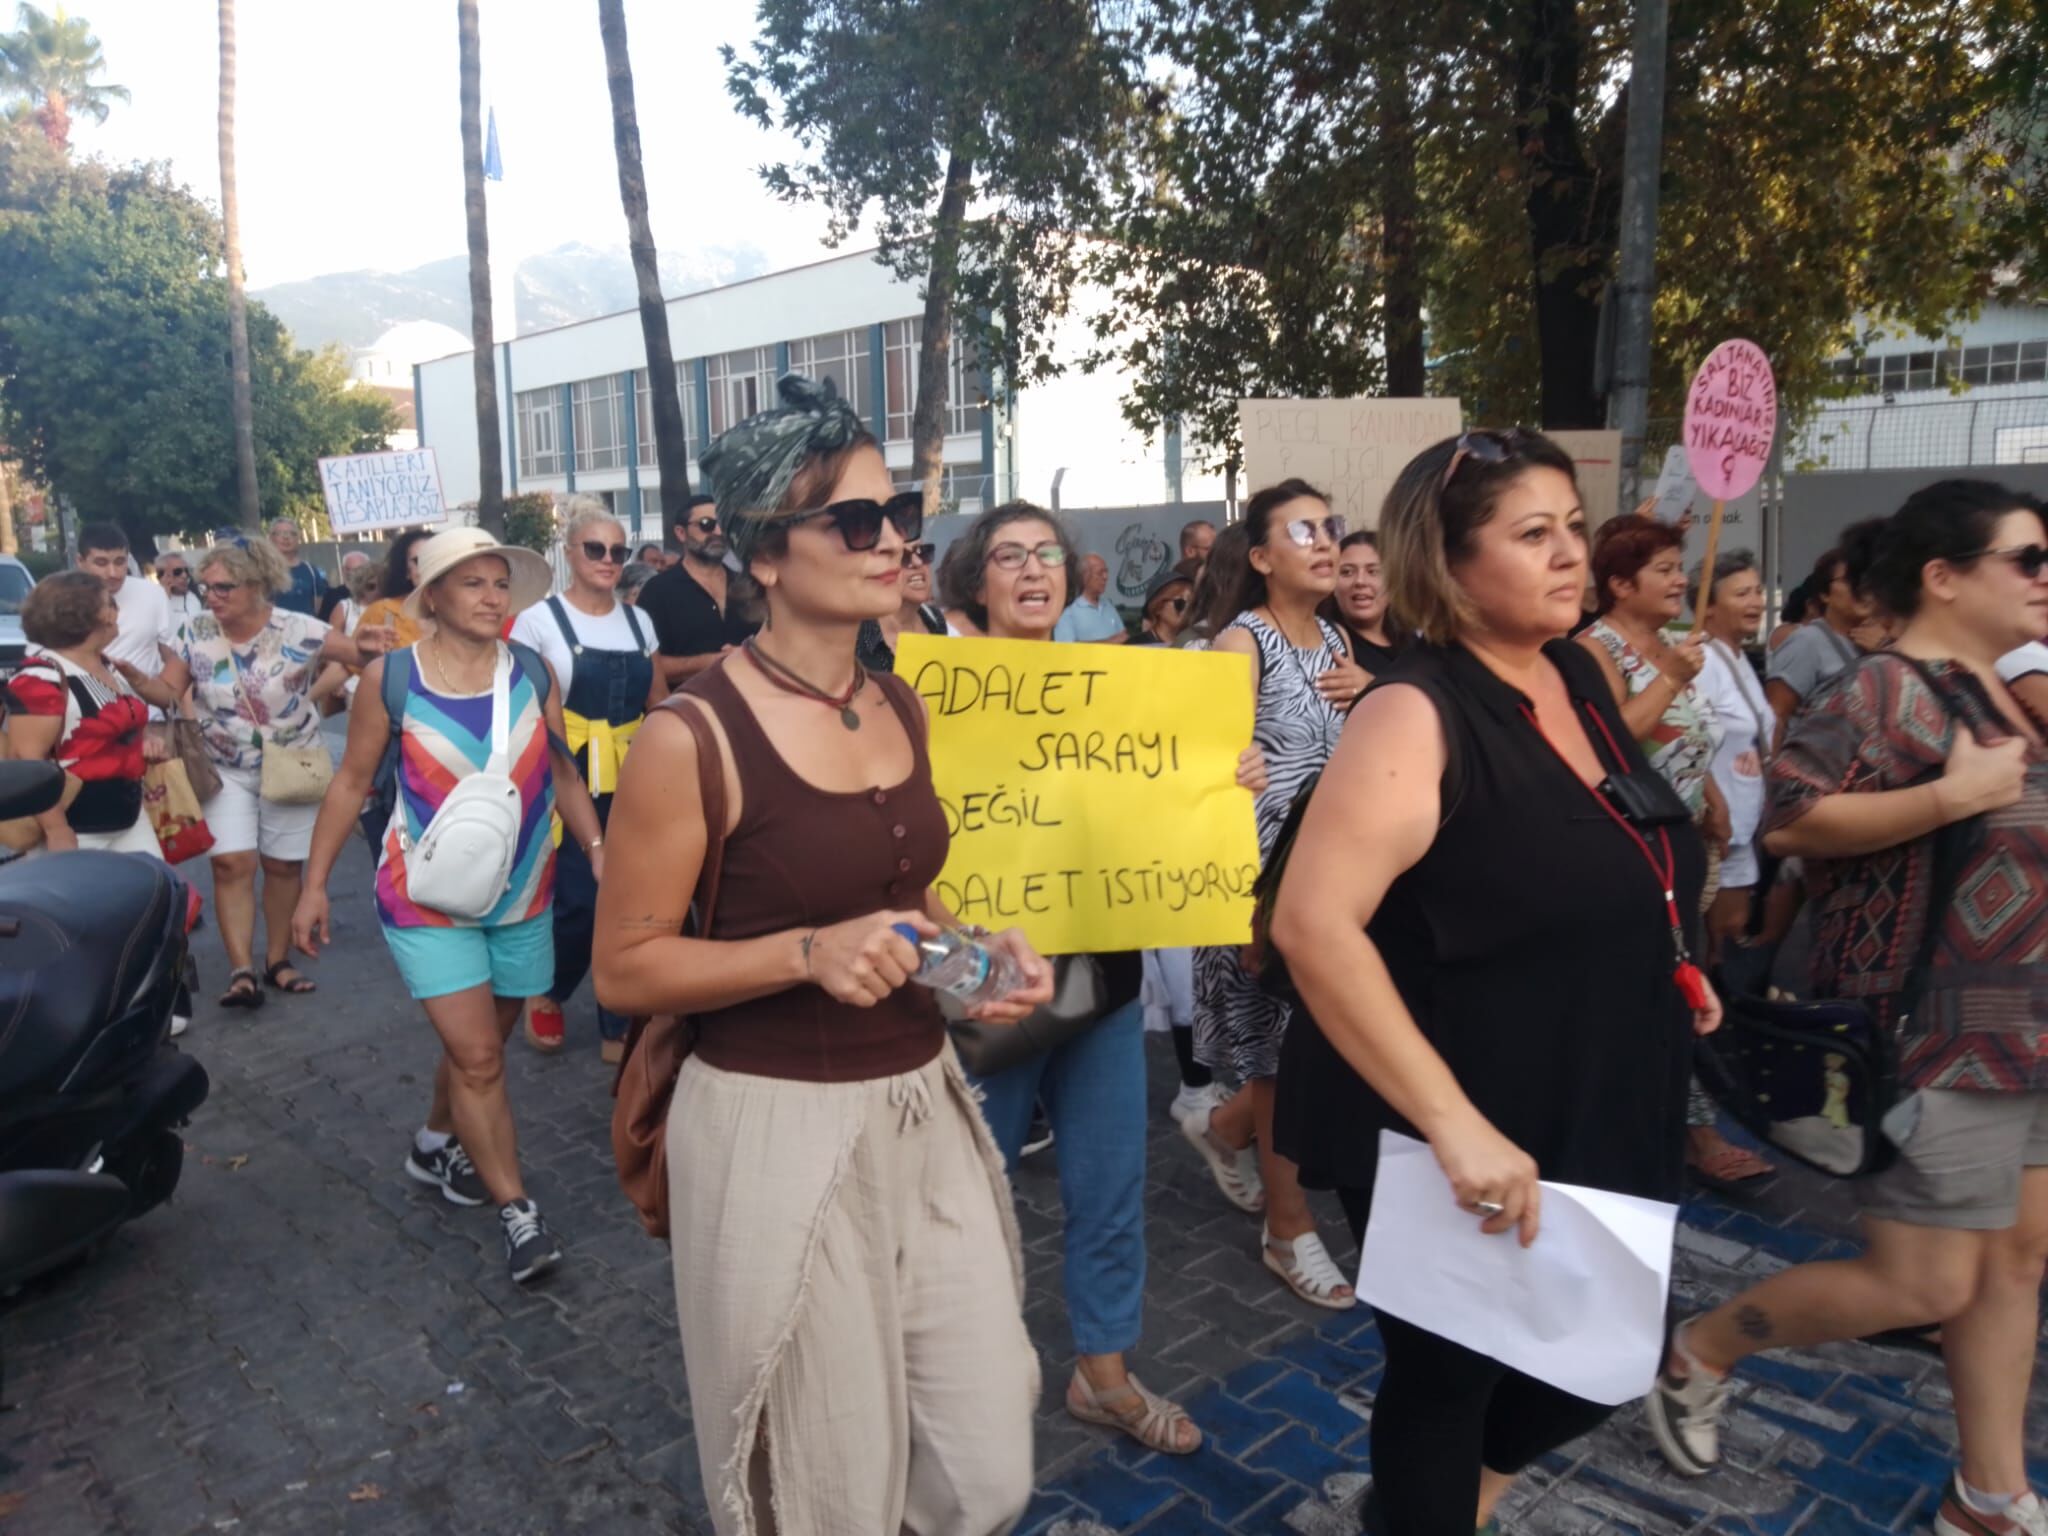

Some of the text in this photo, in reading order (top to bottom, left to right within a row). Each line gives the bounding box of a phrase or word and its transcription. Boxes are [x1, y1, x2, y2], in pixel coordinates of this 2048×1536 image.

[1693, 396, 1762, 428] KADINLAR
[329, 474, 436, 502] TANIYORUZ
[914, 660, 1107, 716] ADALET
[1019, 731, 1179, 778] SARAYI
[936, 871, 1083, 919] DALET
